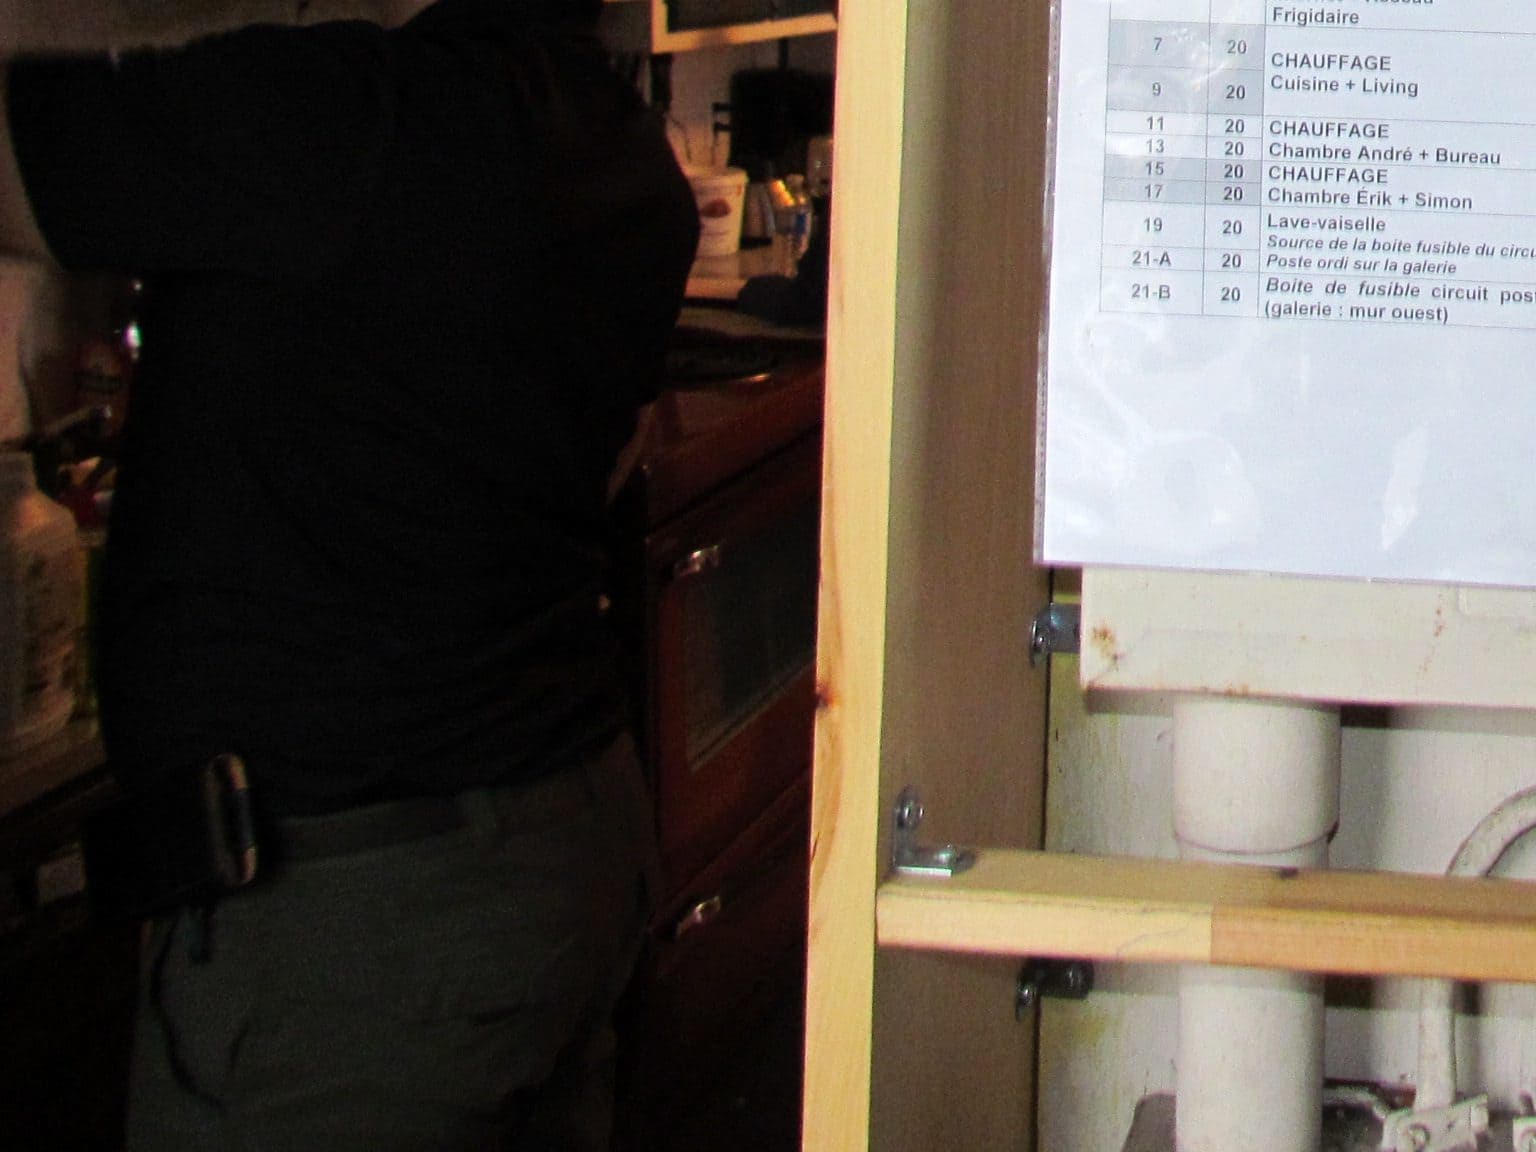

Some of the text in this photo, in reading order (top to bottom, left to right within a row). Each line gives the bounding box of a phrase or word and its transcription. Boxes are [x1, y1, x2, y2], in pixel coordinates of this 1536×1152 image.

[1272, 6, 1360, 27] Frigidaire
[1153, 37, 1392, 72] 7 20 CHAUFFAGE
[1151, 74, 1420, 101] 9 20 Cuisine + Living
[1146, 116, 1390, 139] 11 20 CHAUFFAGE
[1145, 138, 1501, 166] 13 20 Chambre André + Bureau
[1144, 161, 1389, 184] 15 20 CHAUFFAGE
[1144, 183, 1473, 211] 17 20 Chambre Érik + Simon
[1143, 213, 1387, 236] 19 20 Lave-vaiselle
[1267, 234, 1324, 249] Source
[1328, 236, 1349, 250] de
[1352, 237, 1367, 251] la
[1371, 238, 1412, 253] boite
[1416, 239, 1471, 256] fusible
[1475, 242, 1496, 257] du
[1132, 250, 1457, 276] 21-A 20 Poste ordi sur la galerie
[1131, 283, 1171, 300] 21-B
[1221, 286, 1241, 303] 20
[1266, 276, 1314, 294] Boite
[1324, 279, 1347, 295] de
[1358, 280, 1421, 298] fusible
[1431, 284, 1489, 301] circuit
[1264, 299, 1449, 325] (galerie mur ouest)
